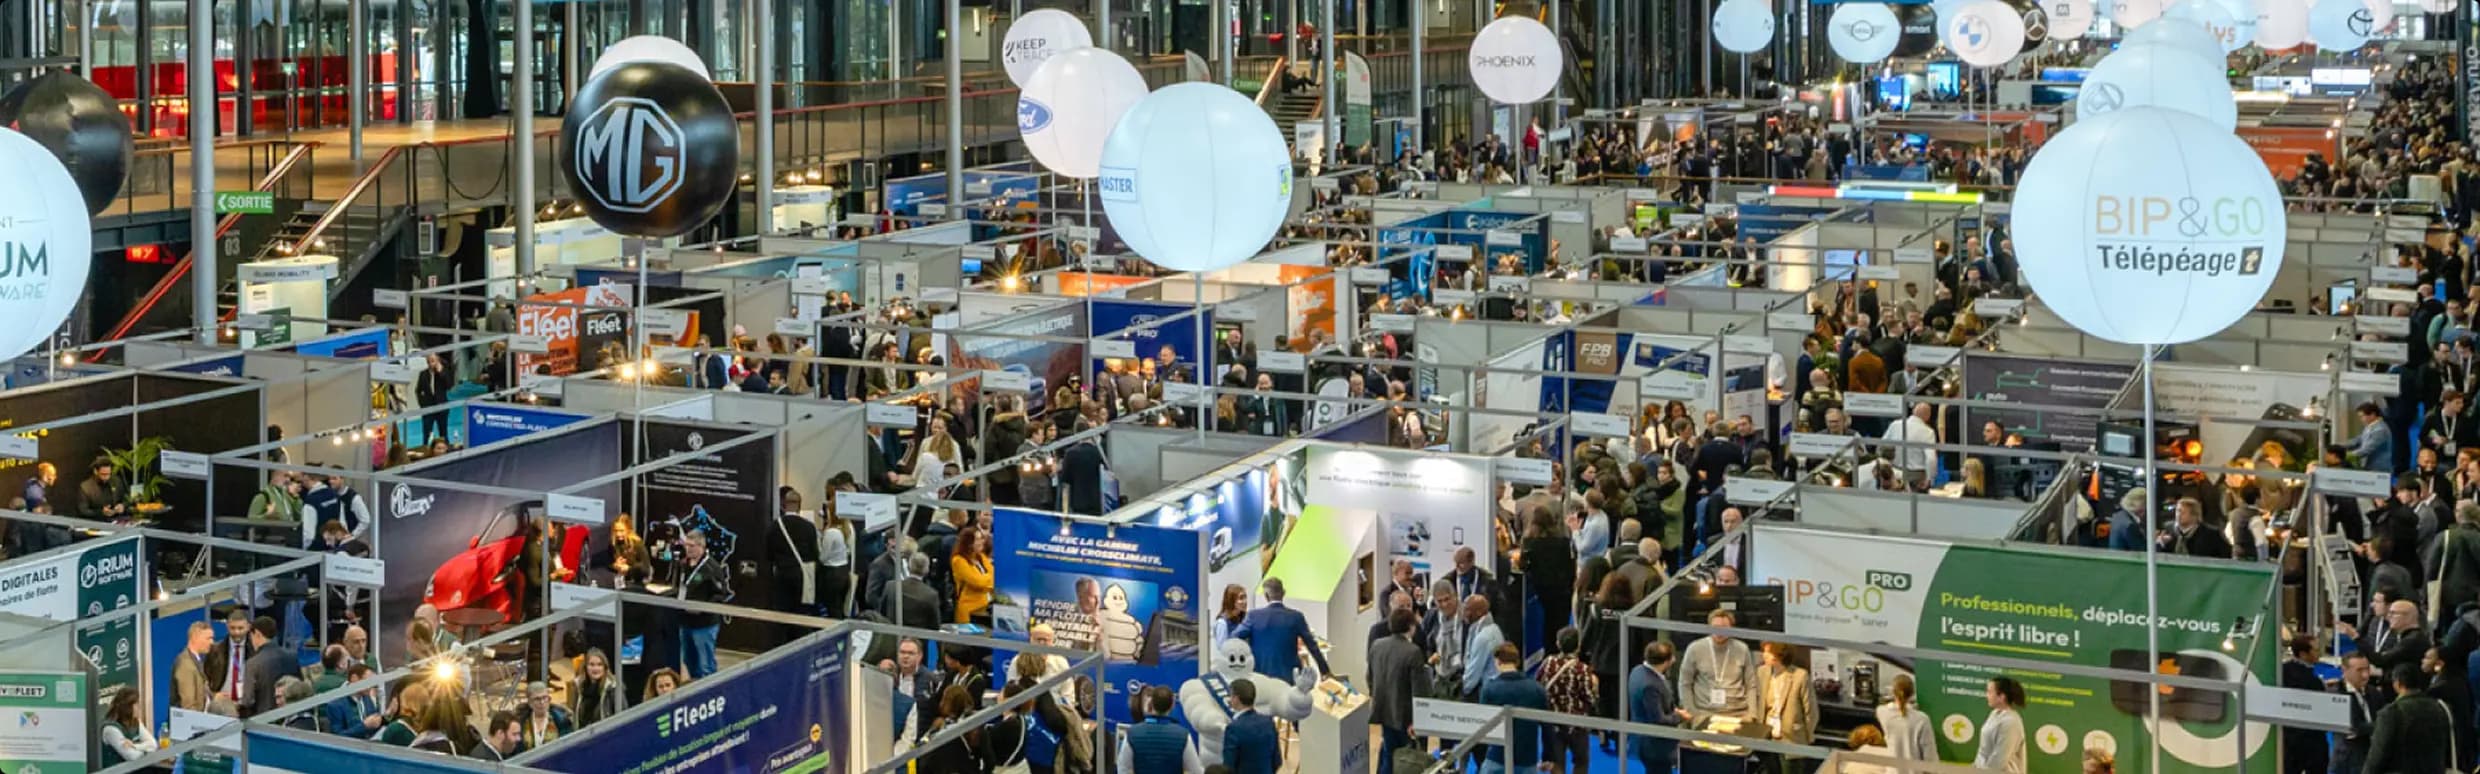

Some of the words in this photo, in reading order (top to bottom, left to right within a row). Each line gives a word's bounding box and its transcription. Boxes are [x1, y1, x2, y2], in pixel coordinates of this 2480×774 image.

[1016, 39, 1046, 50] KEEP
[583, 106, 674, 204] MG
[227, 196, 273, 209] SORTIE
[2097, 243, 2236, 276] Télépéage
[1028, 542, 1079, 555] MICHELIN
[1051, 535, 1079, 545] AVEC
[1080, 538, 1094, 546] LA
[1095, 539, 1139, 551] GAMME
[98, 552, 133, 575] IRIUM
[2, 566, 58, 592] DIGITALES
[1871, 573, 1907, 589] PRO
[1768, 577, 1884, 613] IP&GO
[1034, 608, 1052, 617] MA
[1940, 592, 2079, 622] Professionnels,
[2082, 605, 2221, 634] déplacz-vous
[2019, 624, 2070, 647] libre
[673, 695, 726, 731] Flease
